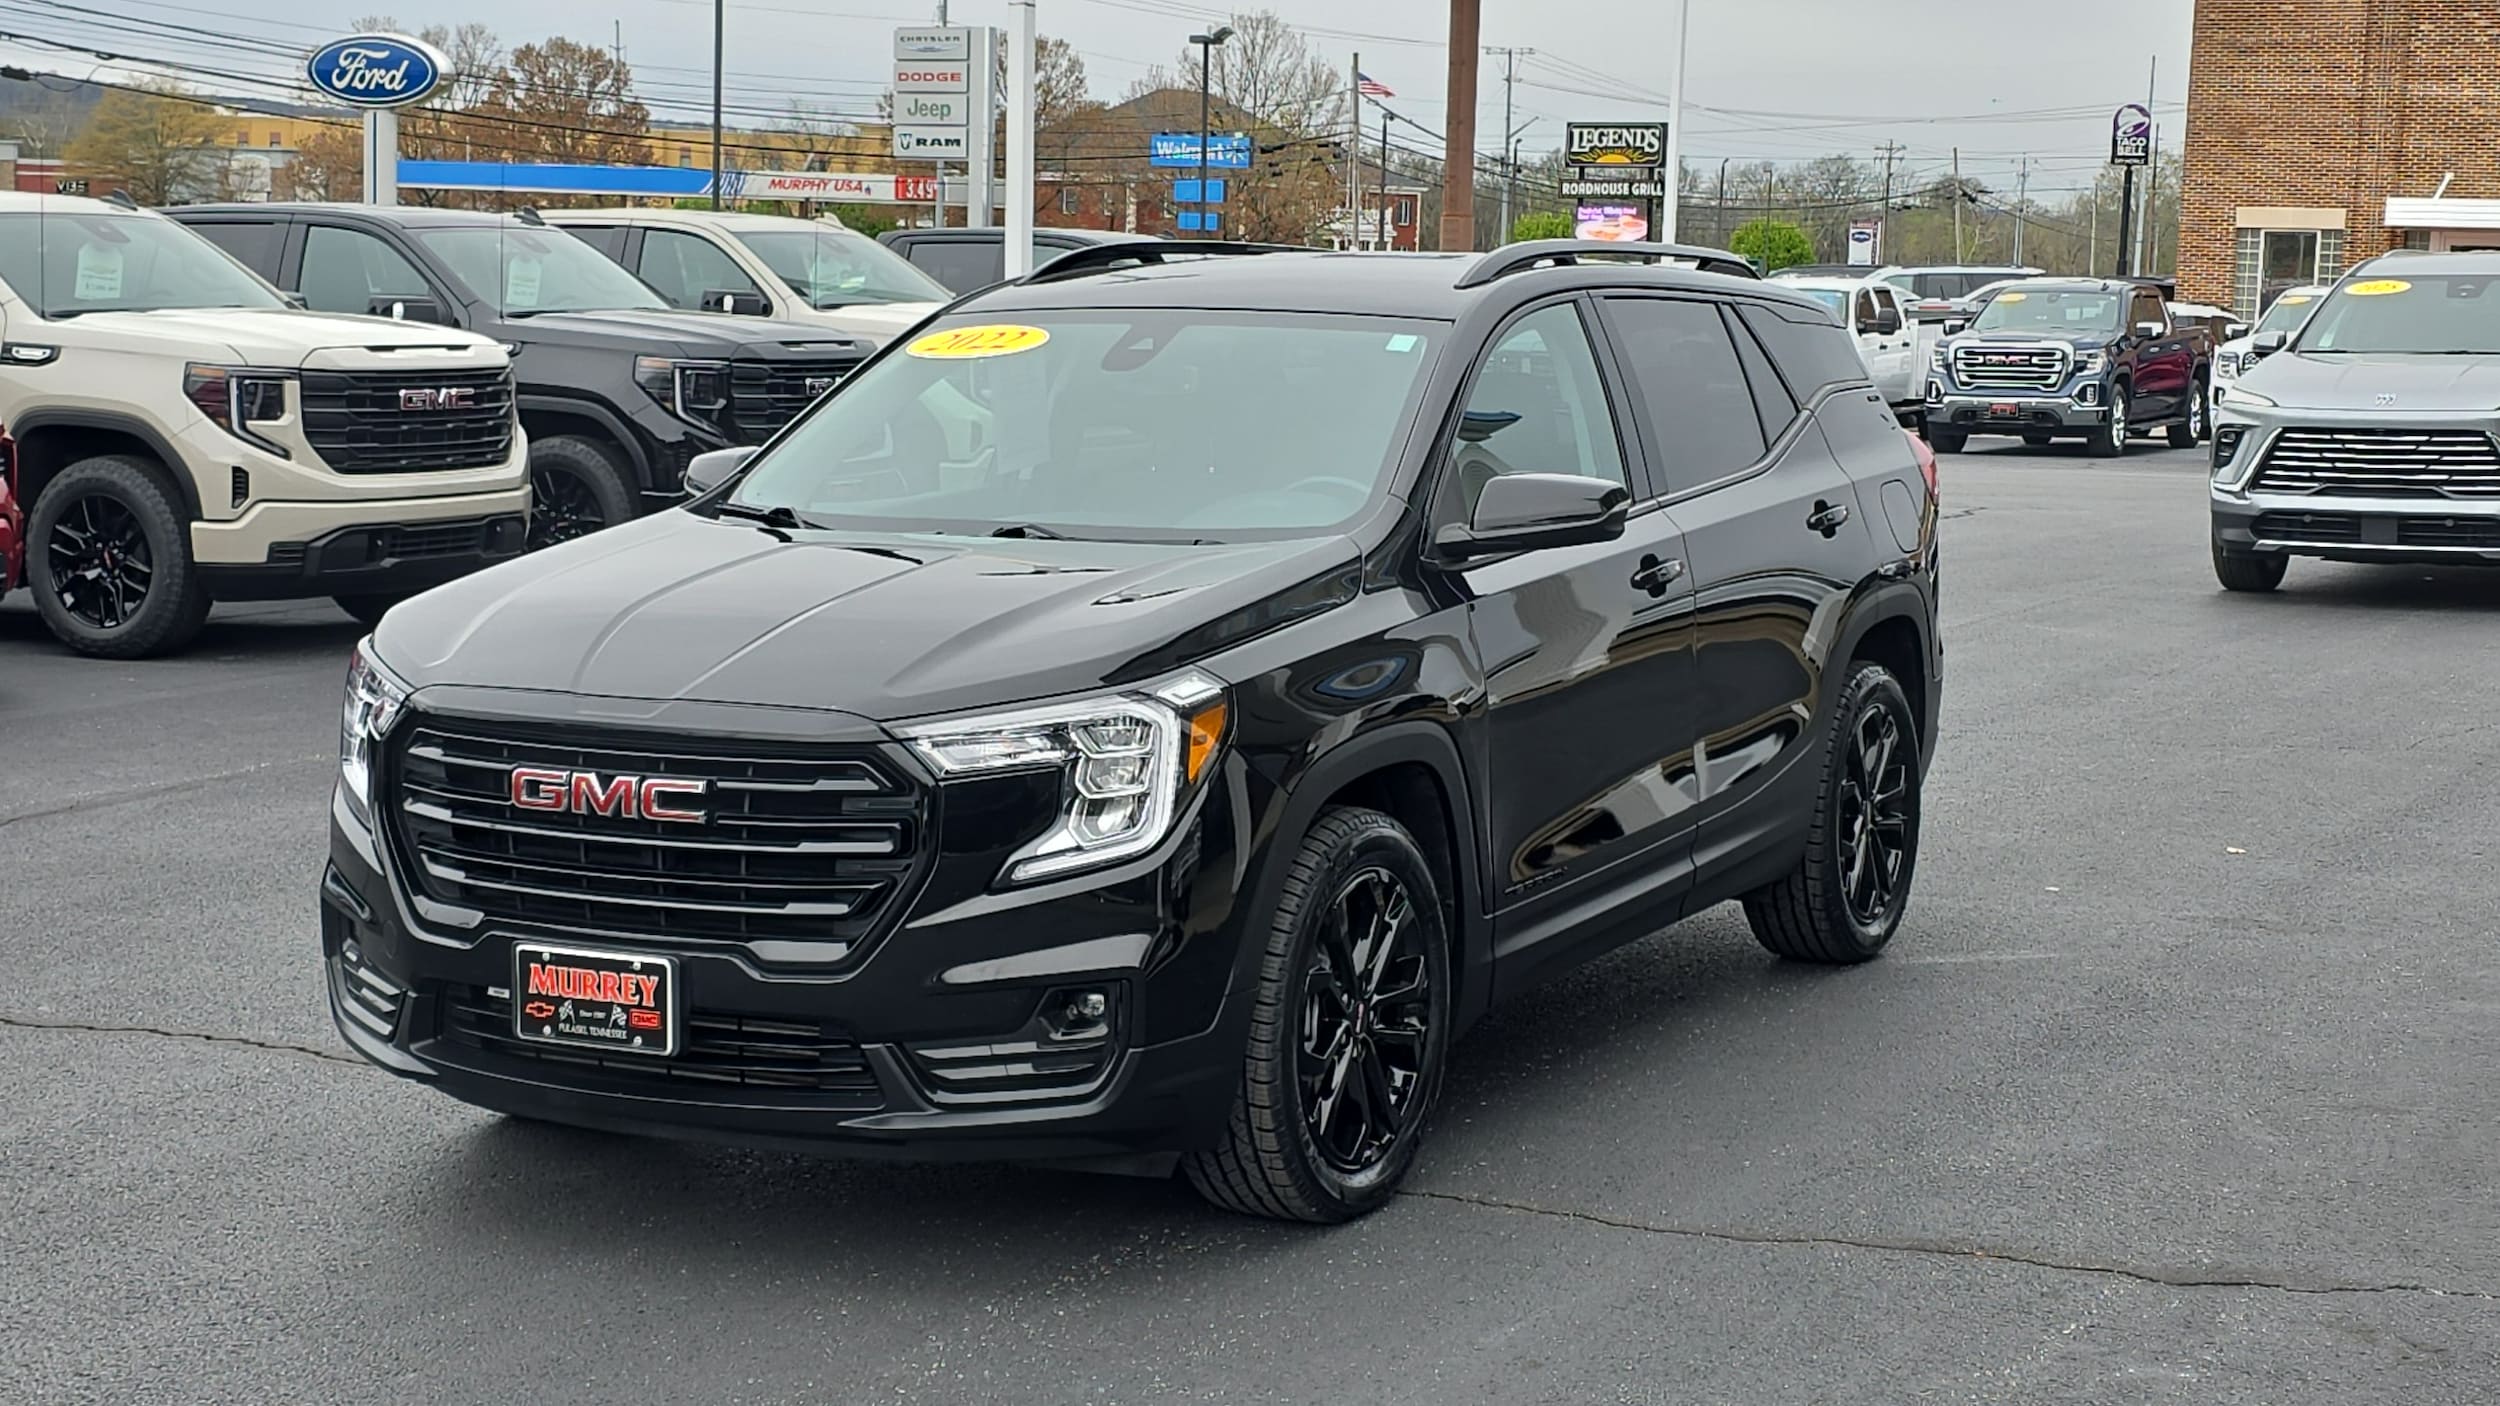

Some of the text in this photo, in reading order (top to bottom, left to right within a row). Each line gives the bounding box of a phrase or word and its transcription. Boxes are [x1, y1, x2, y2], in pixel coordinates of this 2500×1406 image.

[331, 47, 410, 91] Ford
[898, 72, 961, 82] DODGE
[907, 98, 951, 121] Jeep
[915, 137, 961, 147] RAM
[1570, 127, 1660, 153] LEGENDS
[2116, 136, 2147, 146] TACO
[2117, 145, 2146, 156] BELL
[768, 178, 863, 193] MURPHY USA
[1561, 182, 1664, 196] ROADHOUSE GRILL
[923, 331, 1030, 353] 2022
[1984, 355, 2030, 365] GMC
[399, 387, 475, 411] GMC
[512, 767, 706, 825] GMC
[528, 963, 659, 1008] MURREY
